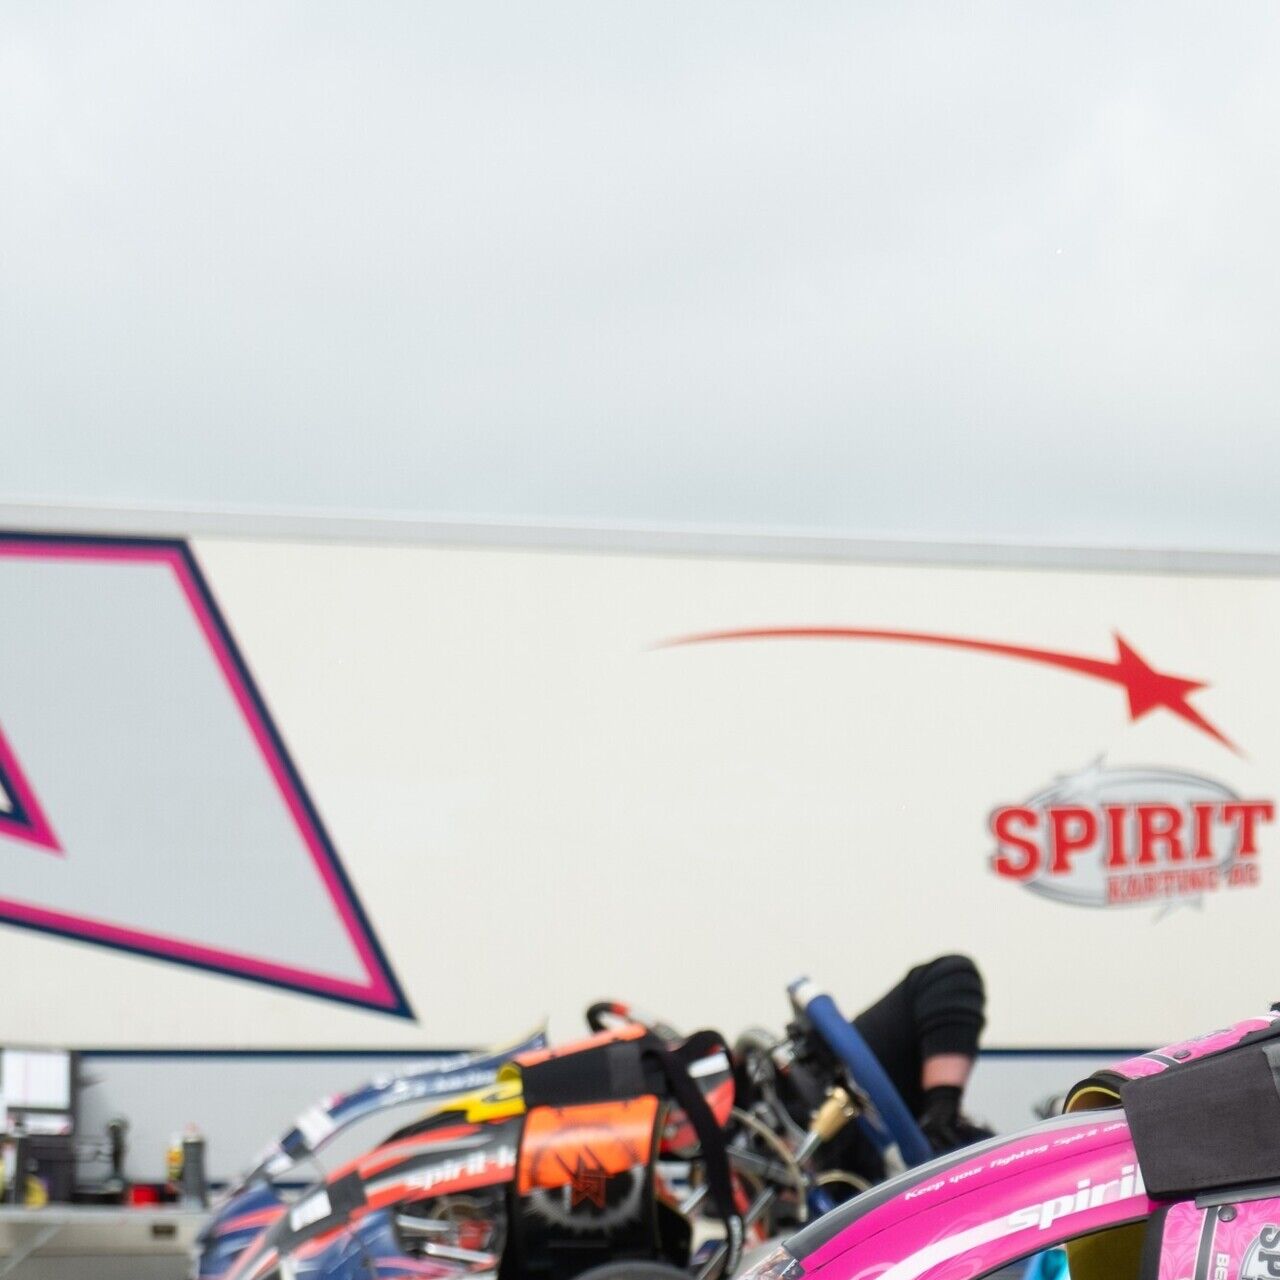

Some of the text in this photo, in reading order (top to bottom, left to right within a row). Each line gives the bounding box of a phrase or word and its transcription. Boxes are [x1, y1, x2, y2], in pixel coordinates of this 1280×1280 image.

[990, 800, 1274, 880] SPIRIT
[904, 1179, 946, 1201] Keep
[949, 1165, 985, 1184] your
